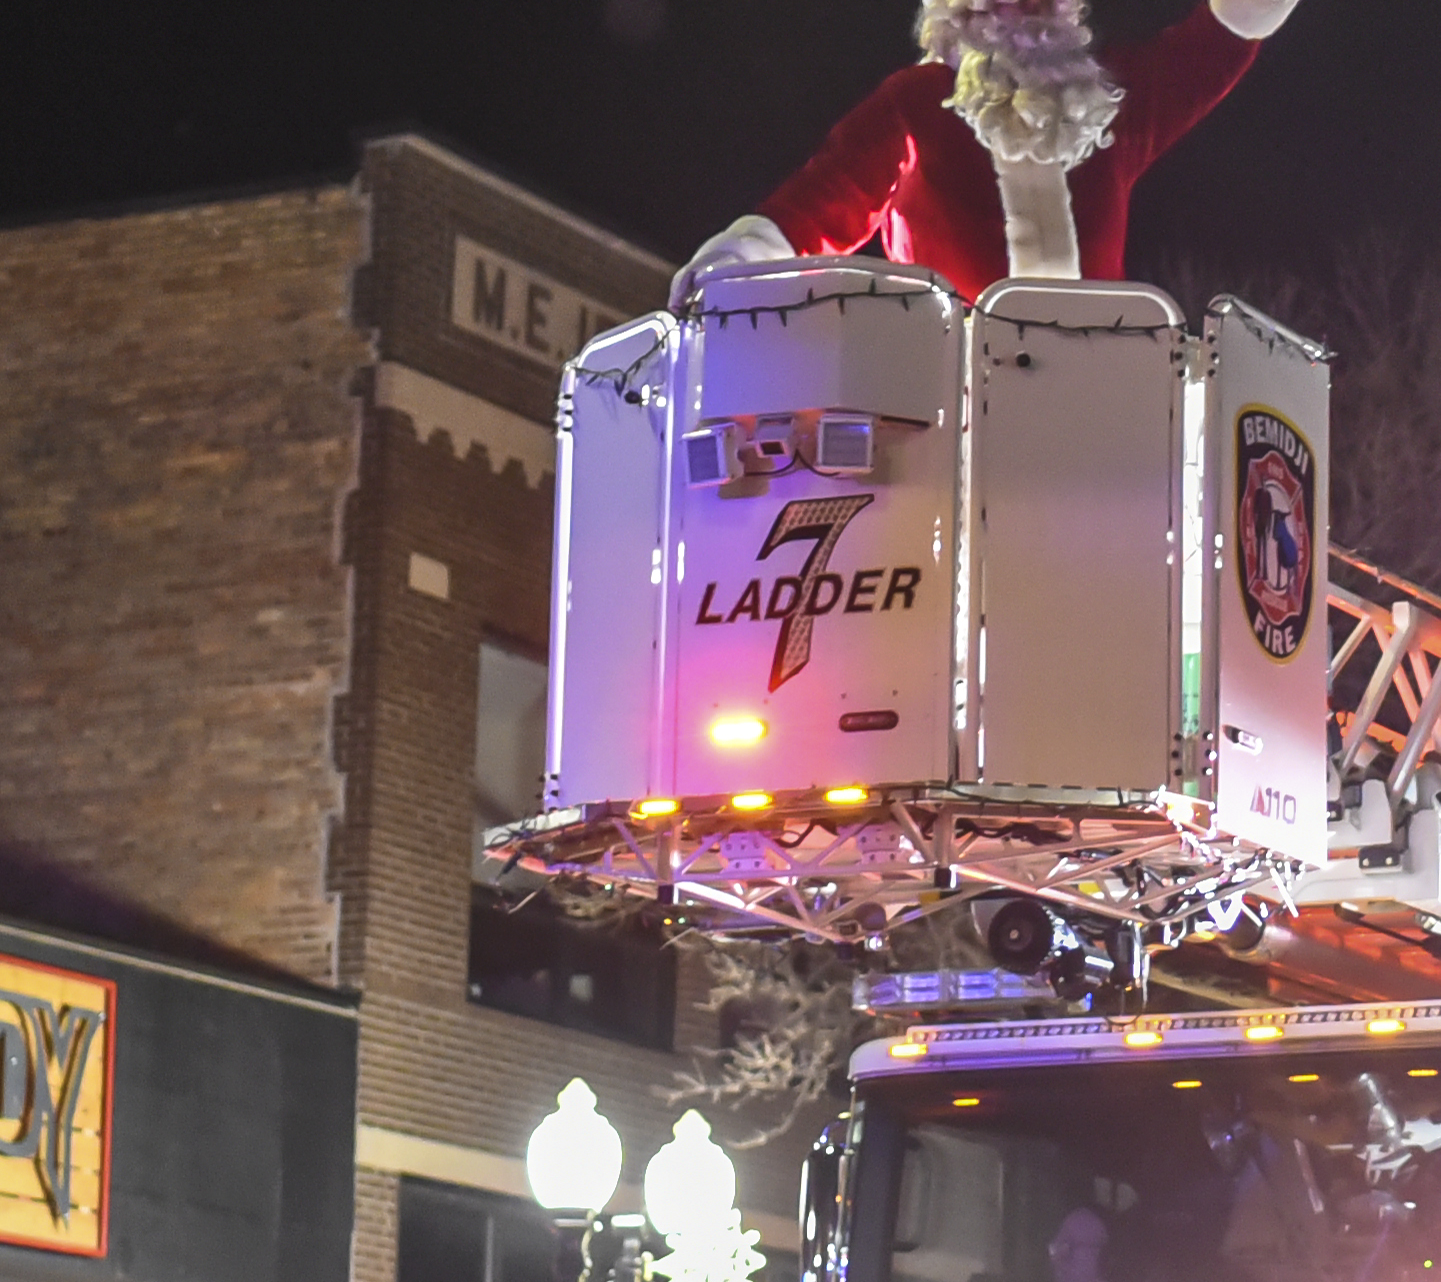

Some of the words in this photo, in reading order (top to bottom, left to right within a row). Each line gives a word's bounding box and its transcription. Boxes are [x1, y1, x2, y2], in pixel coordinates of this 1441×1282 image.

[1243, 415, 1309, 476] BEMIDJI
[695, 565, 922, 625] LADDER
[756, 494, 875, 693] 7
[1254, 610, 1296, 656] FIRE
